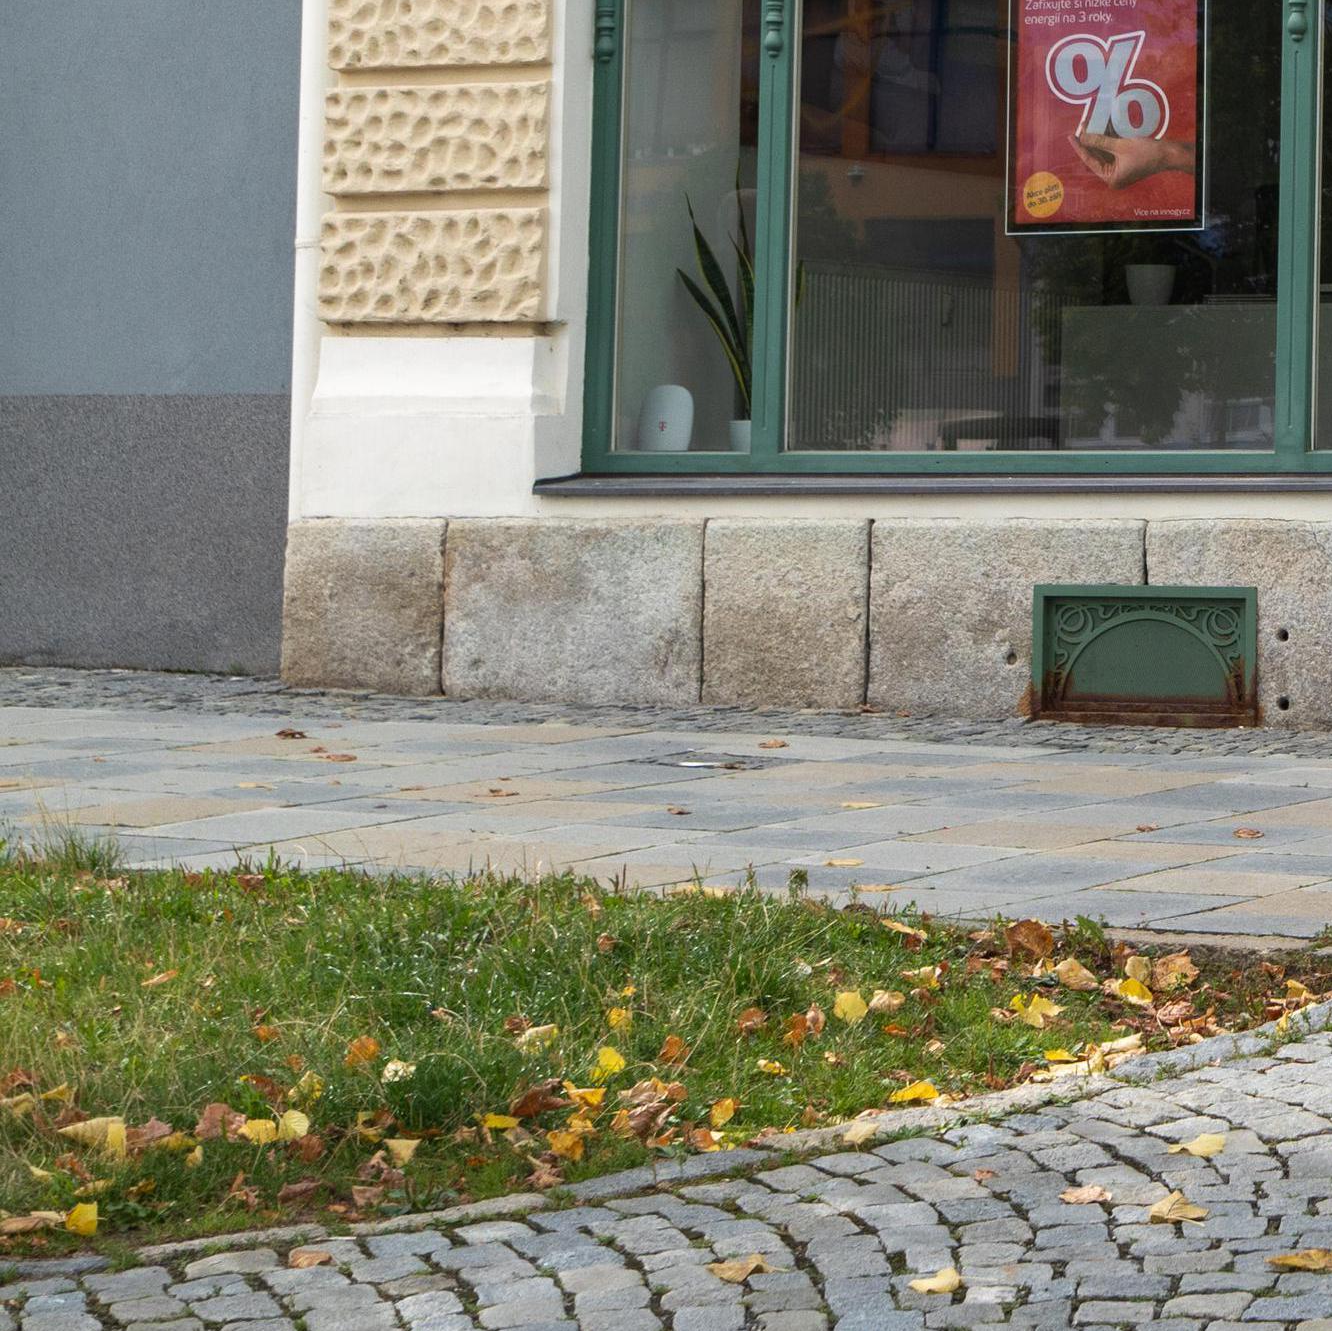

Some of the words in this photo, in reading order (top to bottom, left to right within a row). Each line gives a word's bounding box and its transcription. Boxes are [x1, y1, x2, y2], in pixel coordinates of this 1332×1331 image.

[1024, 12, 1061, 27] energií
[1063, 14, 1076, 24] na
[1078, 11, 1086, 23] 3
[1088, 11, 1113, 25] roky.
